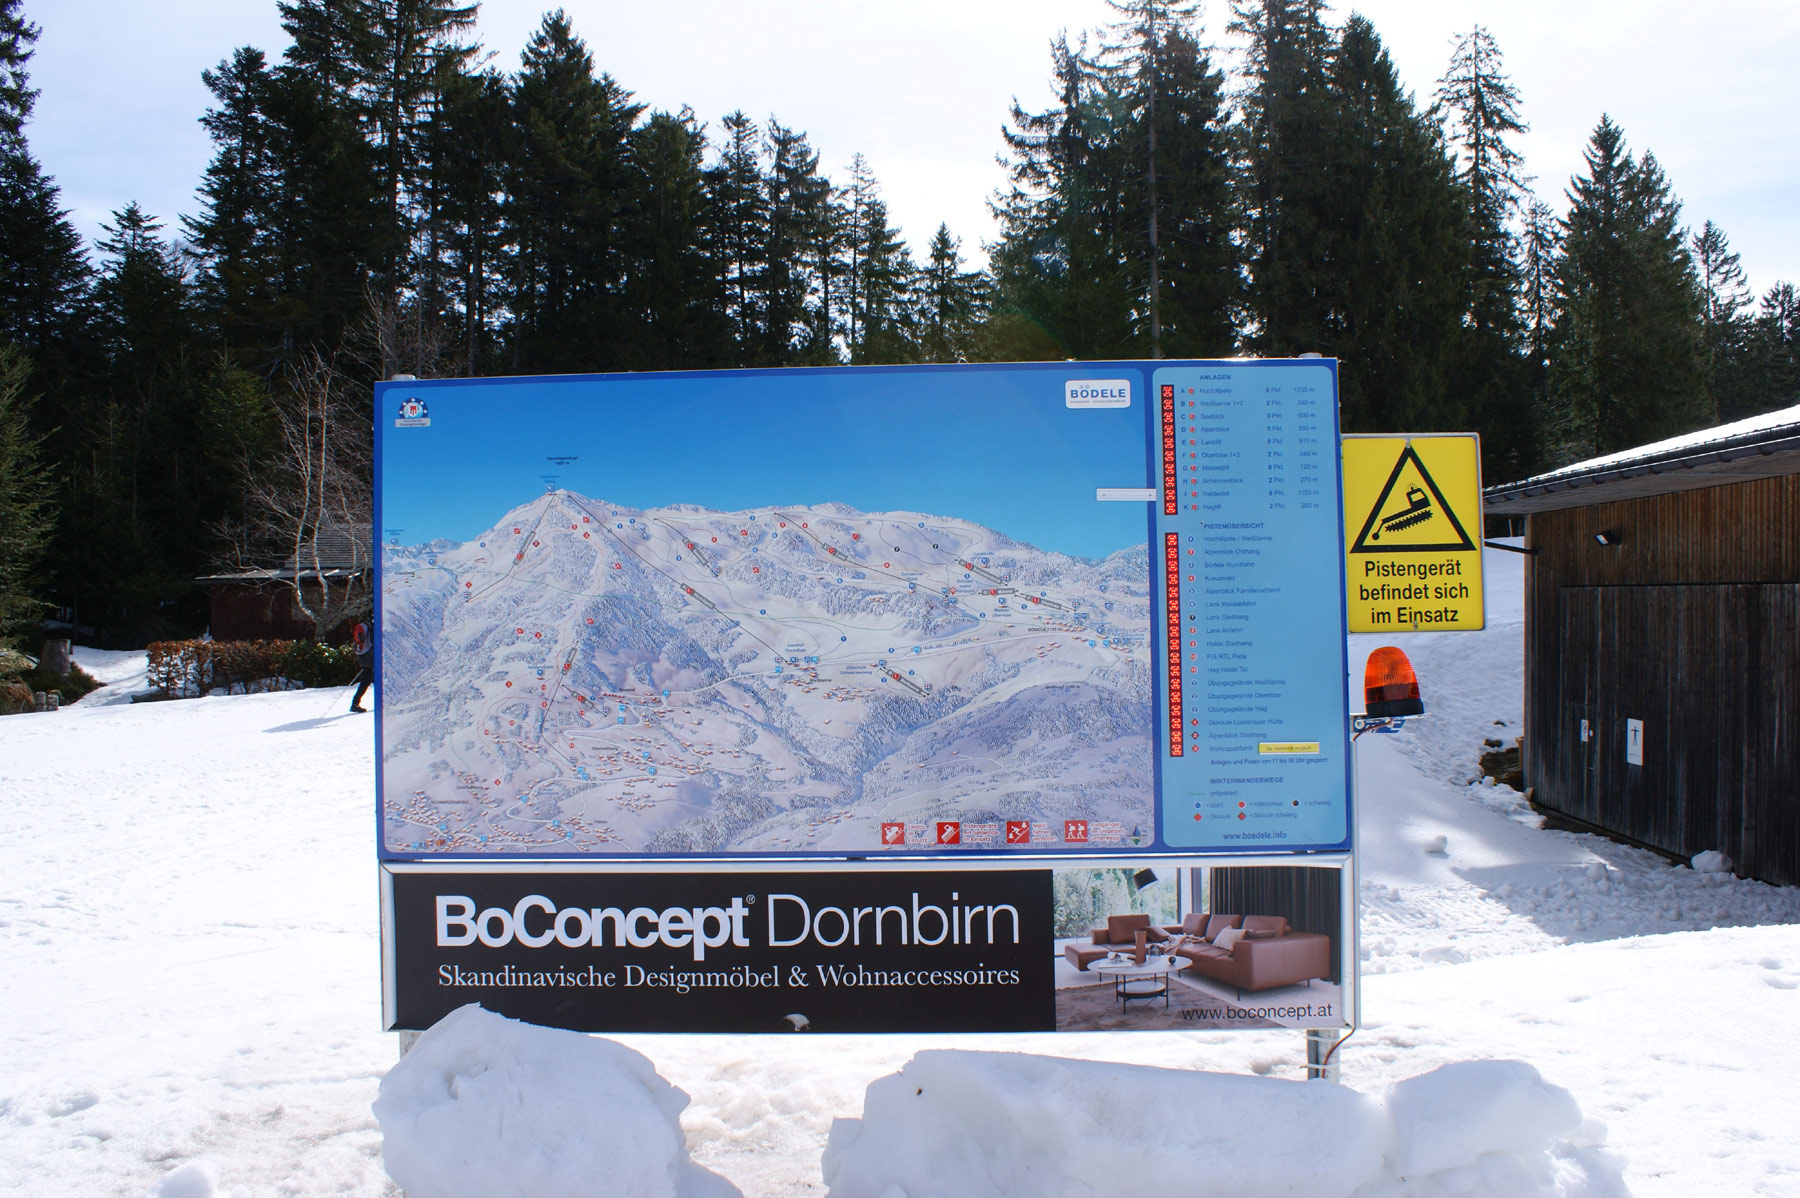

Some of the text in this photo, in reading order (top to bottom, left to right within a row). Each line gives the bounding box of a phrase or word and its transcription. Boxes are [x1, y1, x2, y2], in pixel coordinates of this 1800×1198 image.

[1365, 559, 1462, 580] Pistengerät
[1360, 583, 1469, 600] befindet sich
[1372, 606, 1459, 623] im Einsatz
[768, 892, 1020, 947] Dornbirn
[438, 963, 1020, 994] Skandinavische Designmöbel & Wohnaccessoires
[1182, 1004, 1332, 1020] www.boconcept.at
